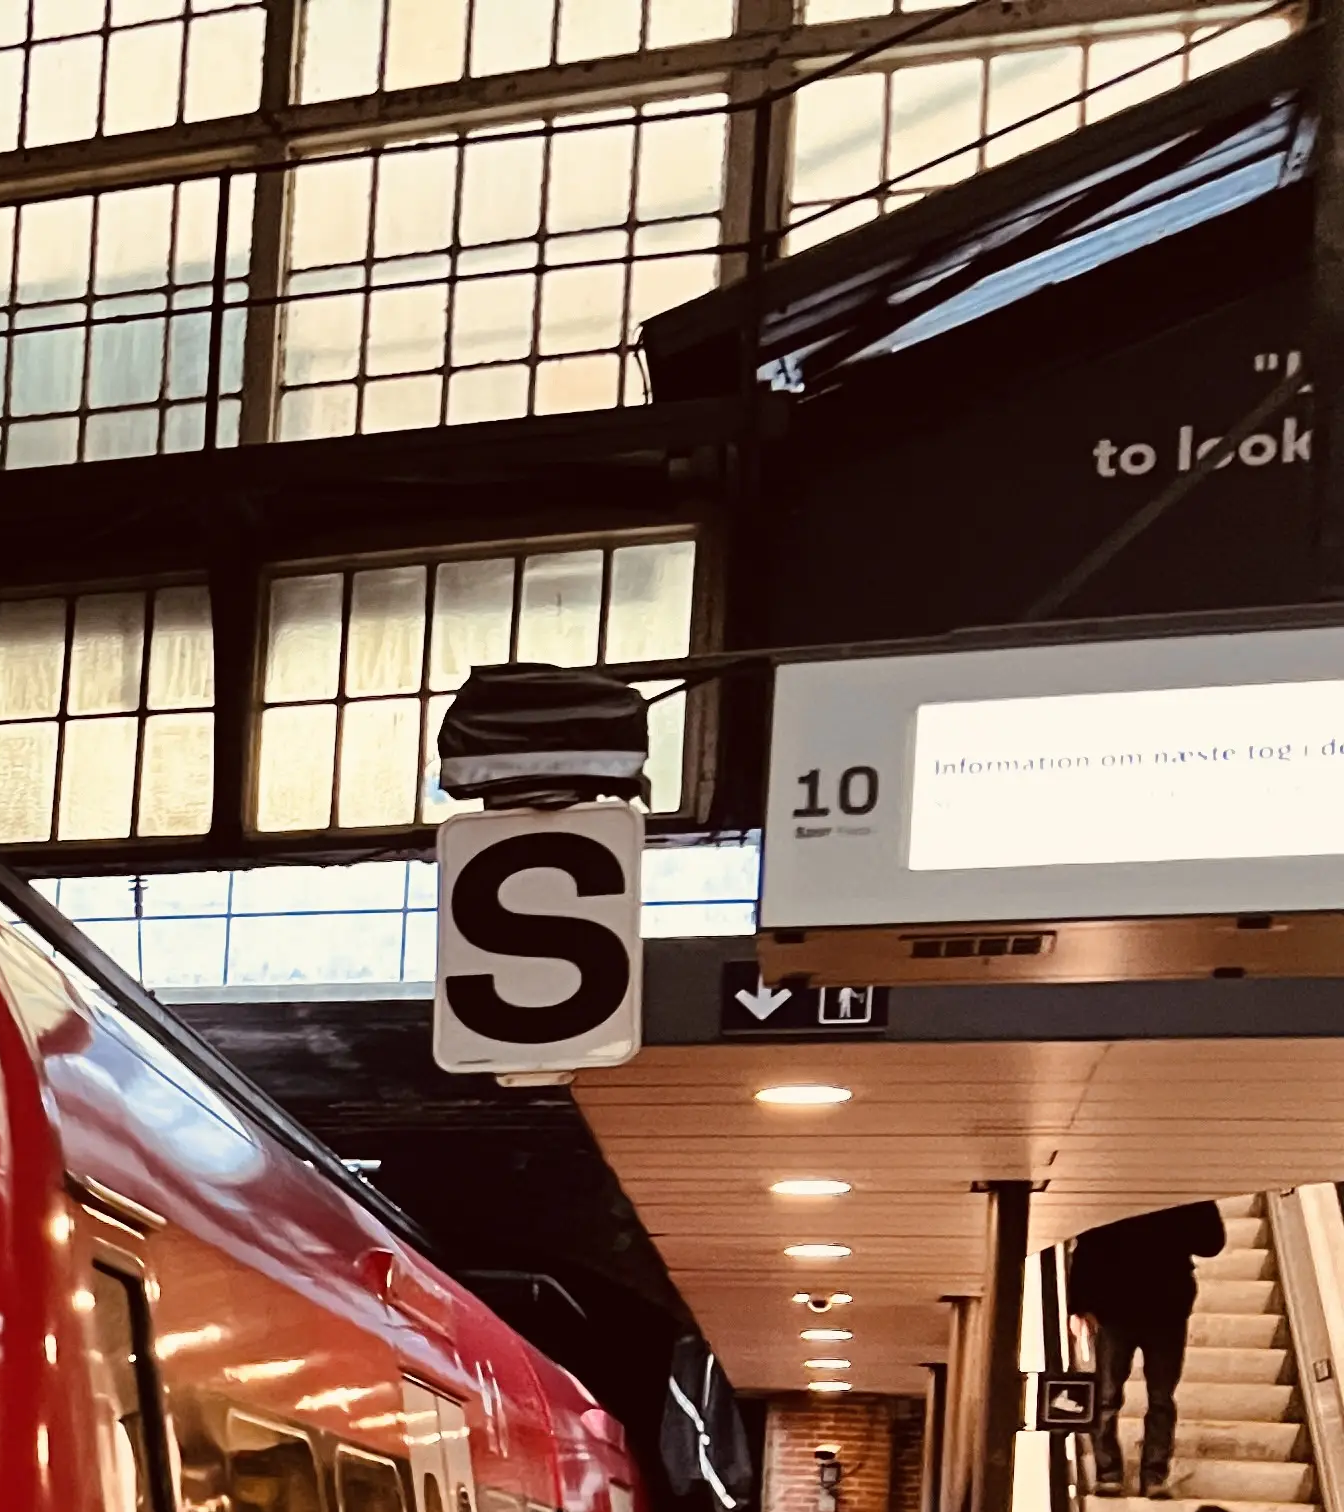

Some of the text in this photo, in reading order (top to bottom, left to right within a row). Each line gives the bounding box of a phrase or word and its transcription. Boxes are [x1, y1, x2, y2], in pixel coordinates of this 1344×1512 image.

[1092, 438, 1158, 477] to
[934, 755, 1090, 776] Information
[1100, 753, 1142, 768] om
[1248, 743, 1292, 762] tog
[792, 765, 880, 819] 10
[445, 831, 631, 1045] S
